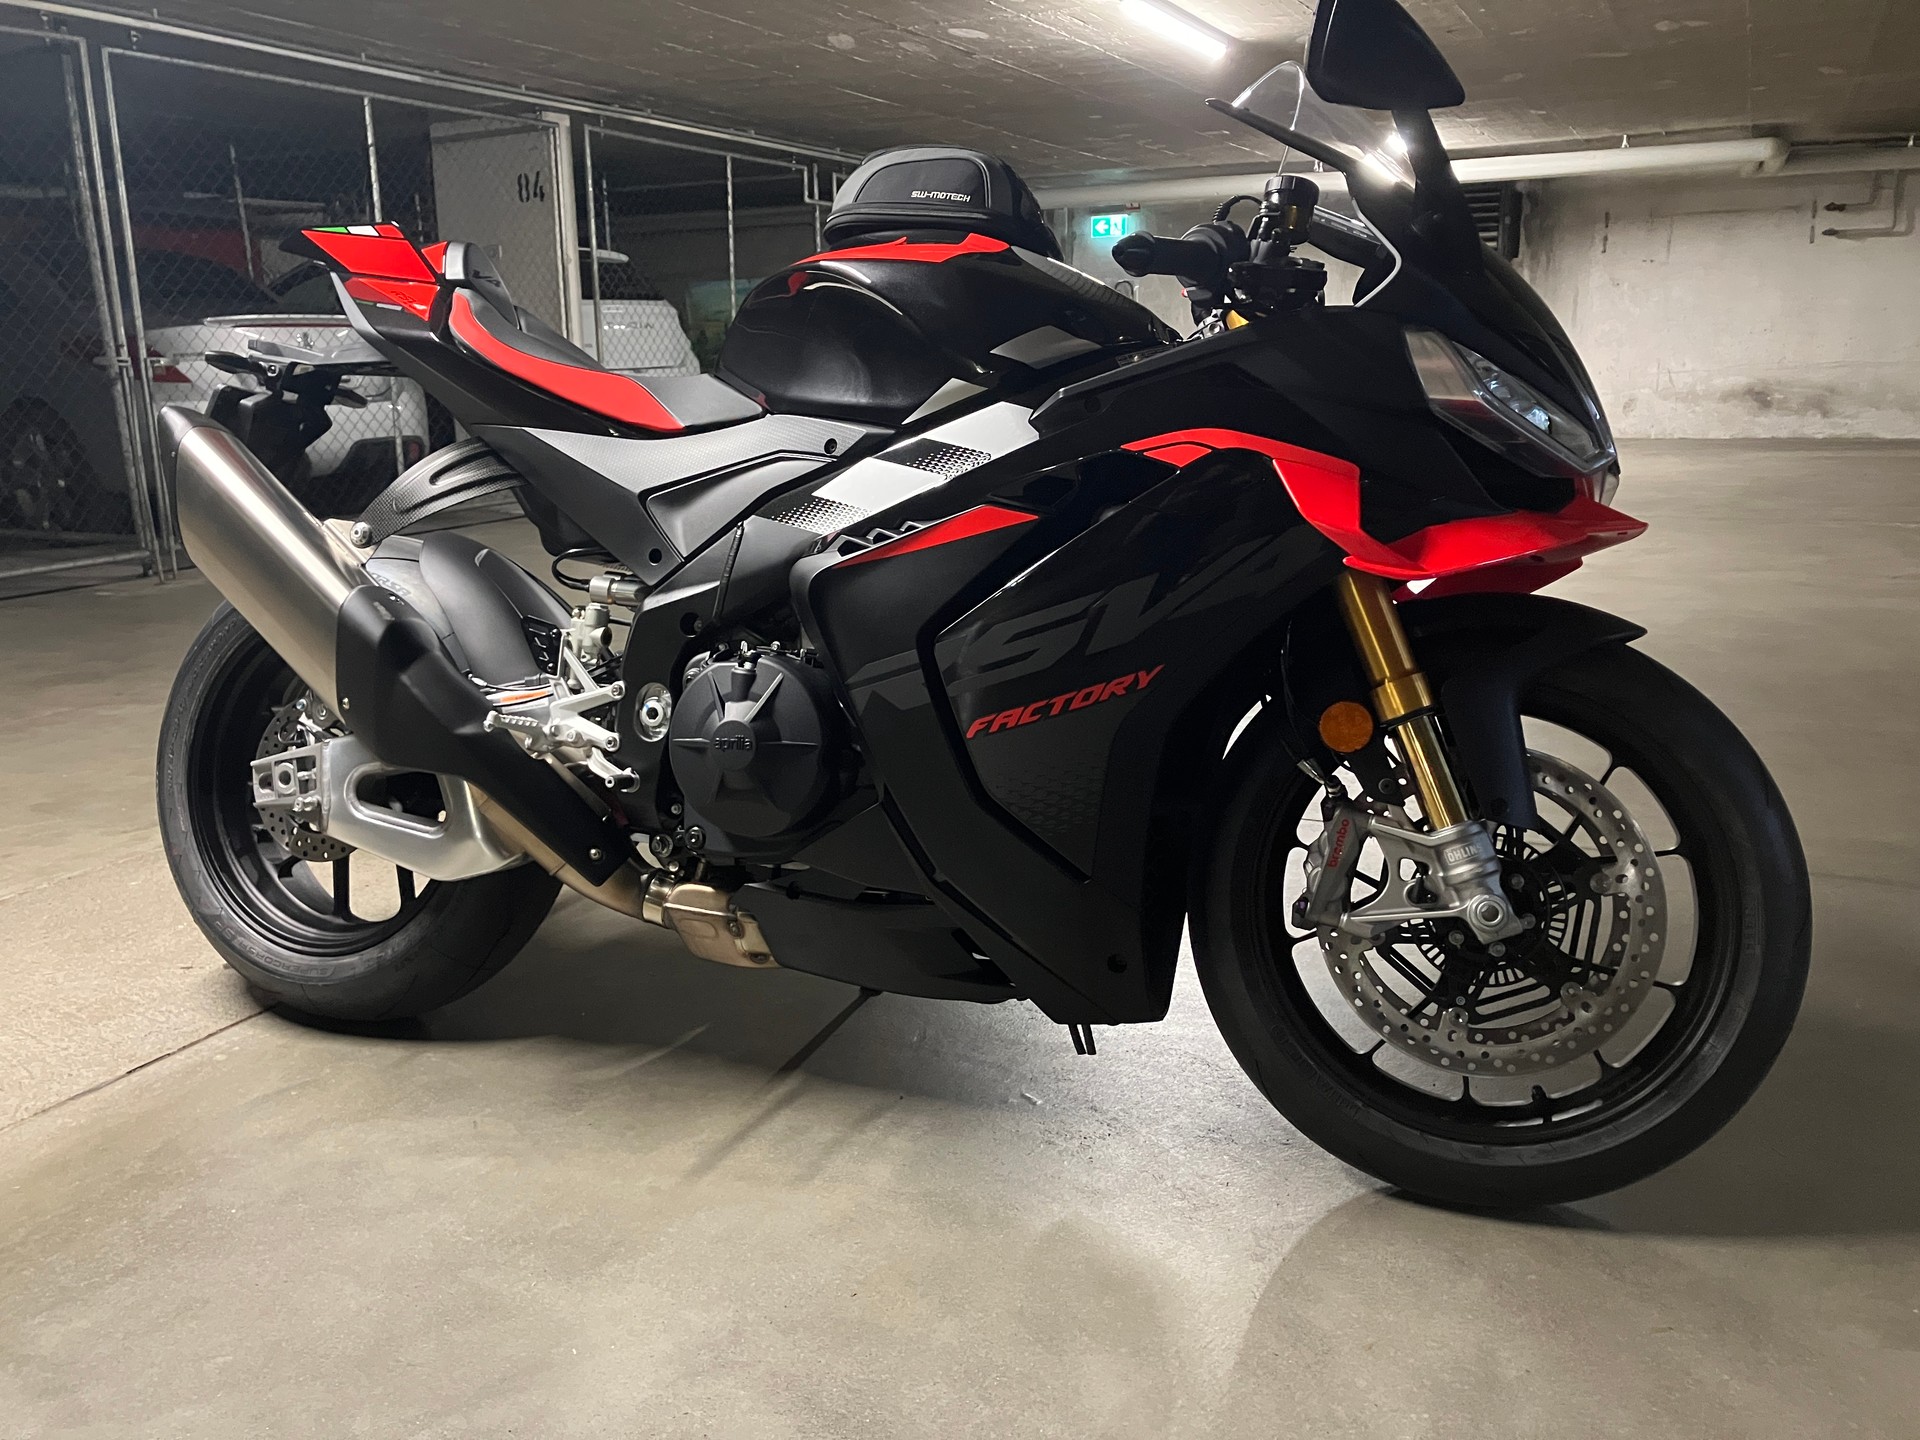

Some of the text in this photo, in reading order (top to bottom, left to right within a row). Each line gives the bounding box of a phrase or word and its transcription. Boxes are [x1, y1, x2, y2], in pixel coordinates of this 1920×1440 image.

[517, 170, 545, 203] 84
[910, 190, 971, 203] SW-MOTECH
[966, 664, 1166, 740] FACTORY
[714, 734, 753, 753] aprilia
[1327, 819, 1350, 868] brembo
